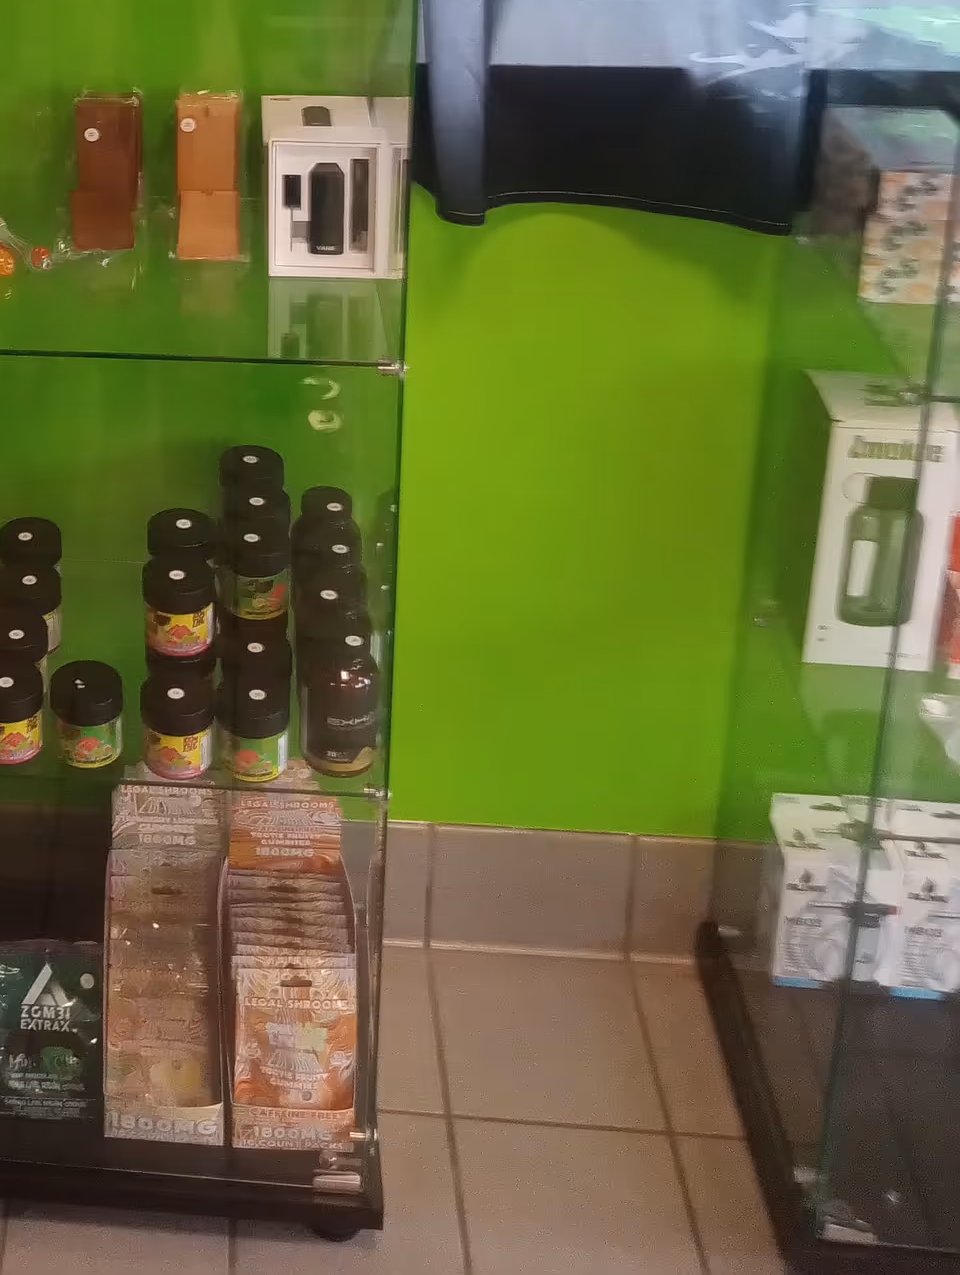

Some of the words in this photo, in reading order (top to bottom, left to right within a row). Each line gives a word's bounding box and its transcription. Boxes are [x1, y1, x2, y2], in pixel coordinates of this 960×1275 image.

[244, 996, 283, 1008] LEGAL
[287, 998, 349, 1011] SHROOMS
[20, 1019, 70, 1033] EXTRAX
